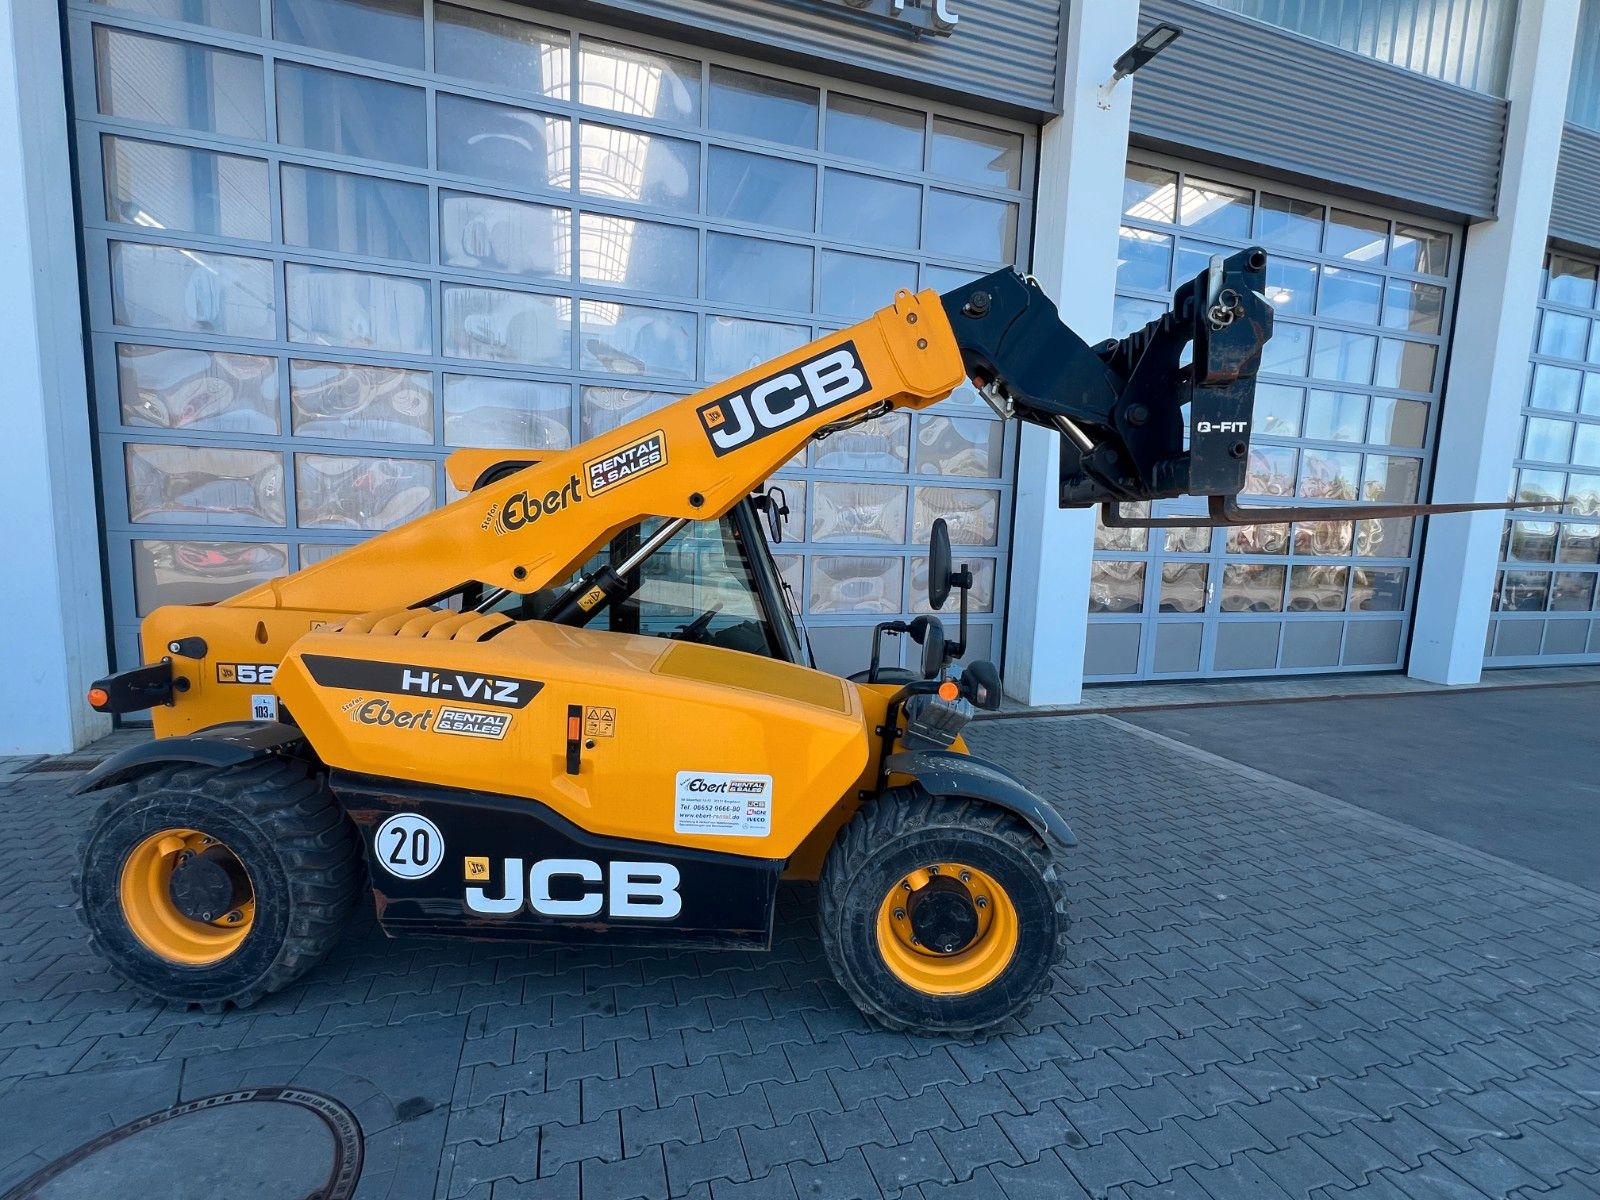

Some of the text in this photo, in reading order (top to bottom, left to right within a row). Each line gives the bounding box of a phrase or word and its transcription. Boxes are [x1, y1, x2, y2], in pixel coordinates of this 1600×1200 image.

[712, 350, 864, 449] JCB
[1197, 421, 1248, 433] Q-FIT
[591, 440, 659, 478] RENTAL
[592, 450, 661, 490] & SALES
[480, 502, 499, 530] Stefan
[502, 474, 582, 531] Ebert
[254, 705, 269, 719] 103
[341, 696, 364, 712] Stefan
[359, 699, 434, 731] Ebert
[442, 711, 504, 726] RENTAL
[439, 720, 502, 735] & SALES
[689, 778, 728, 794] Ebert
[389, 826, 431, 867] 20
[465, 857, 683, 918] JCB
